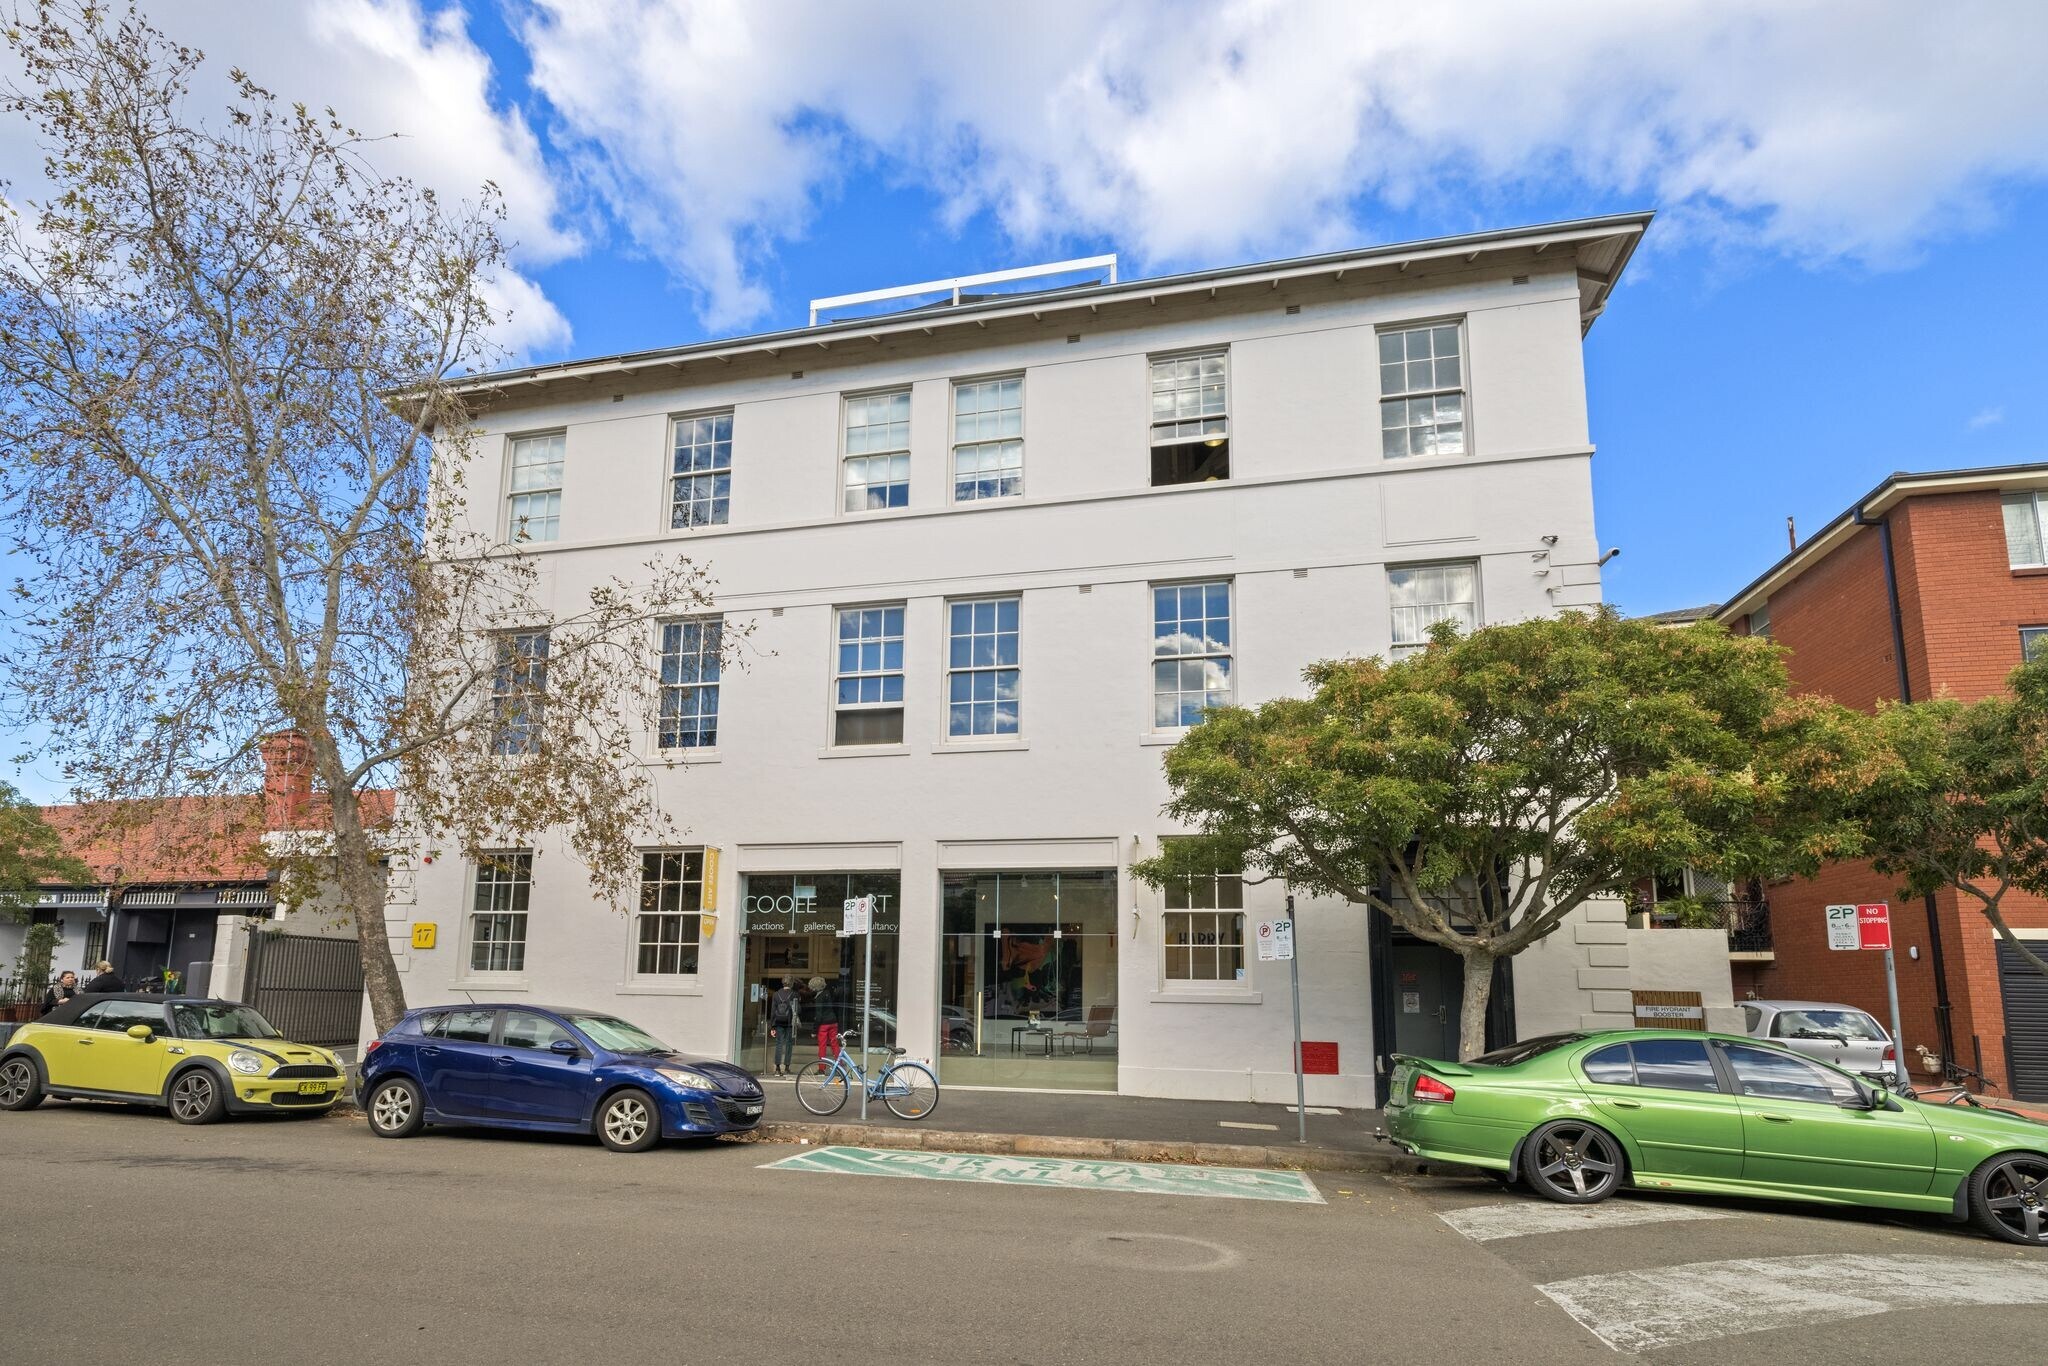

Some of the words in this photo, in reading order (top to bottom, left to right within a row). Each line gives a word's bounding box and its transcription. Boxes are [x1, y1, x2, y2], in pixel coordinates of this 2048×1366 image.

[741, 895, 818, 914] COOEE
[845, 901, 856, 911] 2P
[1829, 908, 1855, 919] 2P
[751, 922, 785, 931] auctions
[803, 922, 836, 932] galleries
[1275, 922, 1291, 933] 2P
[416, 928, 432, 942] 17
[884, 1154, 992, 1166] CAR
[951, 1166, 1120, 1182] ONLY
